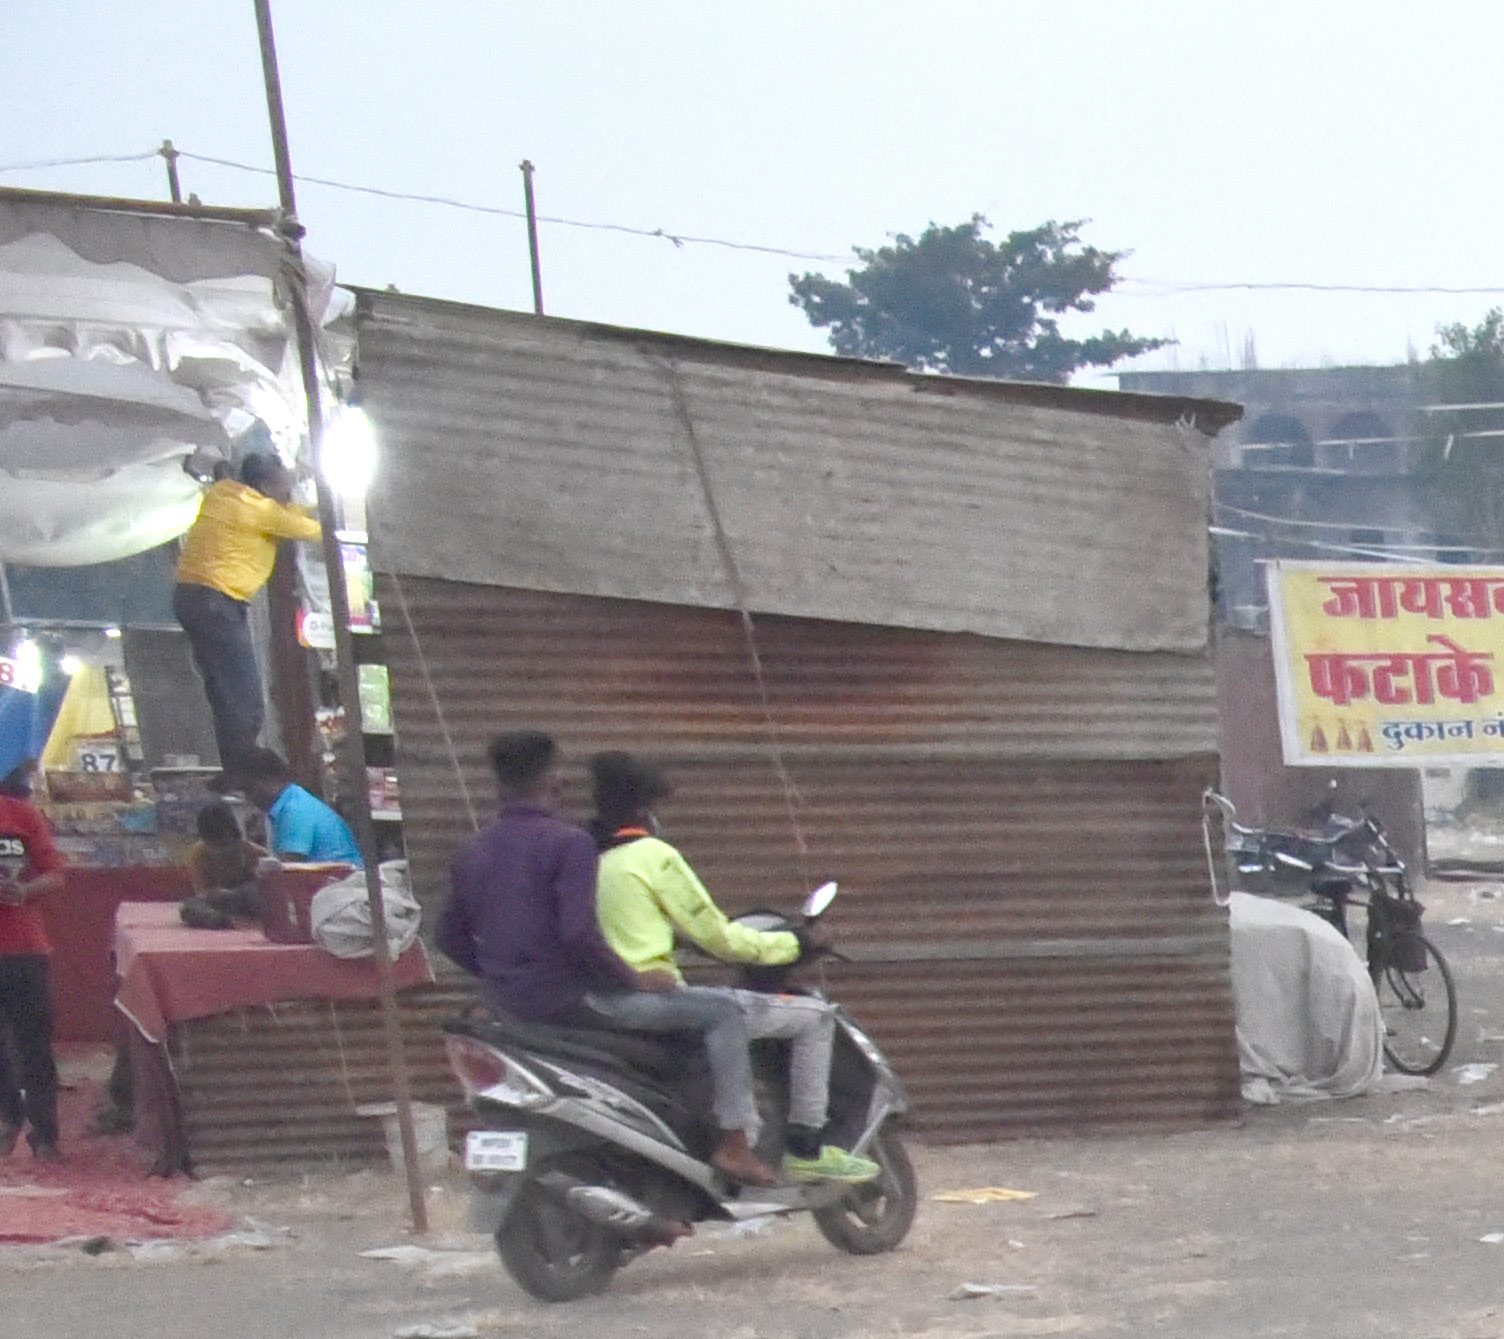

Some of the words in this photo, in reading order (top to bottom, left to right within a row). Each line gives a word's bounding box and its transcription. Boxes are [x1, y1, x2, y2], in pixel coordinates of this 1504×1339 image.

[1304, 634, 1494, 705] फटाके
[1381, 719, 1473, 750] दुकान
[81, 752, 118, 773] 87
